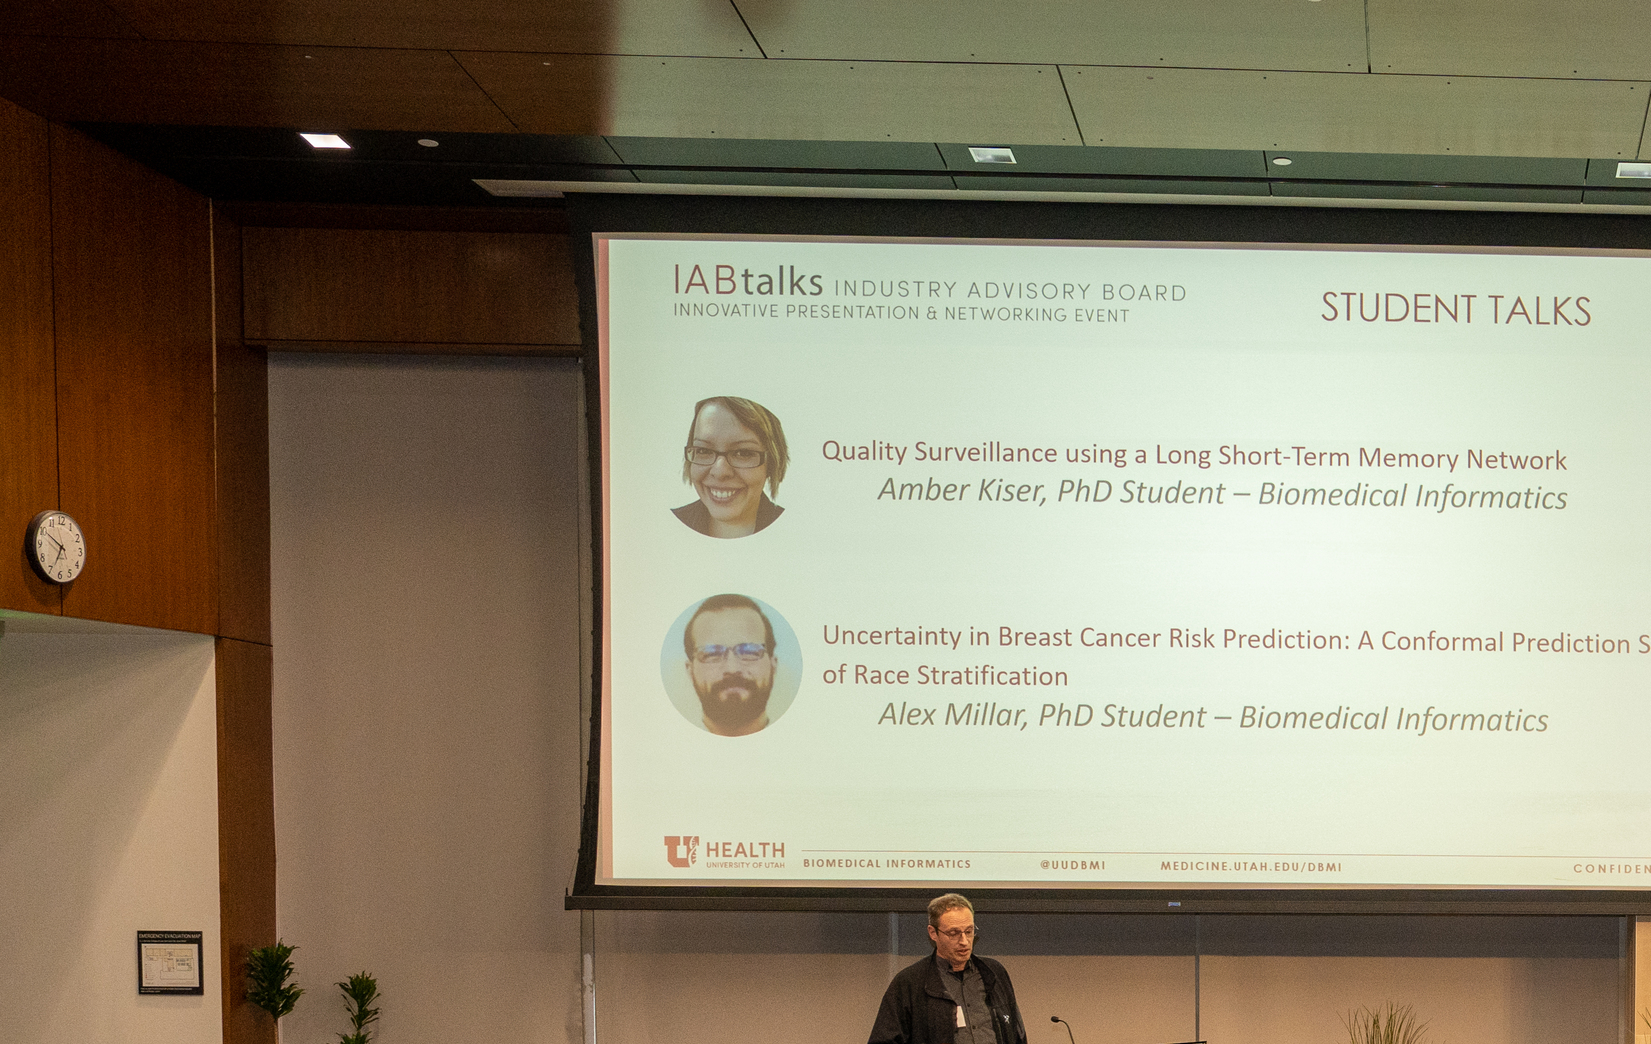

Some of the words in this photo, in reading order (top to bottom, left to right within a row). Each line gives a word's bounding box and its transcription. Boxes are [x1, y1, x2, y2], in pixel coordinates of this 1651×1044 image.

[674, 263, 823, 297] IABtalks
[835, 279, 957, 298] INDUSTRY
[966, 281, 1091, 300] ADVISORY
[1102, 283, 1187, 302] BOARD
[673, 302, 779, 318] INNOVATIVE
[786, 303, 919, 320] PRESENTATION
[926, 305, 938, 321] &
[944, 306, 1068, 323] NETWORKING
[1074, 307, 1130, 323] EVENT
[1321, 291, 1478, 324] STUDENT
[1487, 294, 1592, 327] TALKS
[822, 439, 908, 466] Quality
[914, 440, 1058, 463] Surveillance
[1065, 443, 1128, 469] using
[1134, 448, 1147, 464] a
[1156, 444, 1212, 470] Long
[1218, 444, 1350, 467] Short-Term
[1359, 446, 1460, 474] Memory
[1467, 448, 1568, 471] Network
[876, 476, 971, 502] Amber
[978, 478, 1047, 507] Kiser,
[1057, 478, 1113, 503] PhD
[1119, 479, 1227, 505] Student
[1258, 481, 1408, 508] Biomedical
[1415, 482, 1568, 514] Informatics
[823, 624, 962, 651] Uncertainty
[969, 625, 990, 646] in
[999, 625, 1073, 647] Breast
[1080, 626, 1162, 648] Cancer
[1169, 627, 1216, 649] Risk
[1223, 627, 1350, 650] Prediction:
[1357, 630, 1375, 651] A
[1381, 629, 1504, 652] Conformal
[1512, 631, 1630, 654] Prediction
[822, 662, 848, 685] of
[854, 664, 910, 685] Race
[917, 664, 1068, 687] Stratification
[877, 701, 937, 726] Alex
[944, 701, 1028, 732] Millar,
[1038, 702, 1094, 727] PhD
[1100, 703, 1208, 729] Student
[1239, 705, 1389, 731] Biomedical
[1396, 705, 1549, 737] Informatics
[706, 841, 785, 859] HEALTH
[706, 861, 751, 870] UNIVERSITY
[752, 861, 763, 870] OF
[765, 861, 786, 870] UTAH
[803, 858, 881, 869] BIOMEDICAL
[886, 858, 971, 869] INFORMATICS
[1039, 859, 1106, 871] @UUDBMI
[1160, 860, 1342, 873] MEDICINE.UTAH.EDU/DBMI
